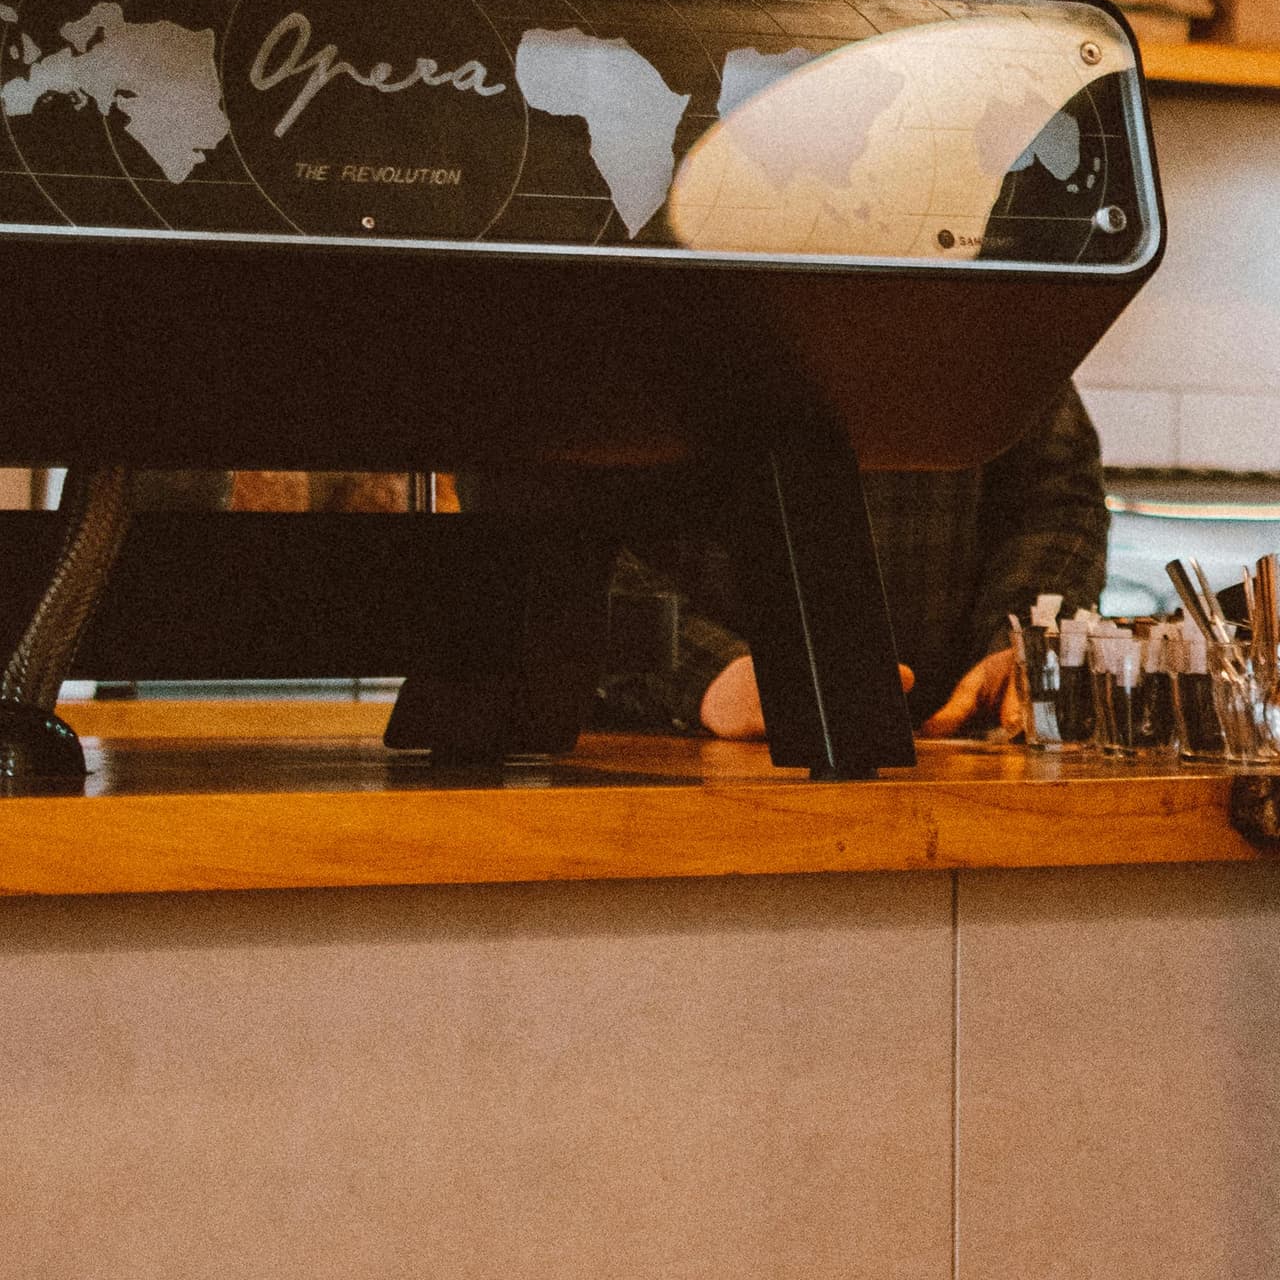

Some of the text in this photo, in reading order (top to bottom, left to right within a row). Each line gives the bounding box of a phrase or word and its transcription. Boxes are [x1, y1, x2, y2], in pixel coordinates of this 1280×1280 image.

[250, 12, 507, 138] Opera
[295, 162, 463, 185] THE REVOLUTION
